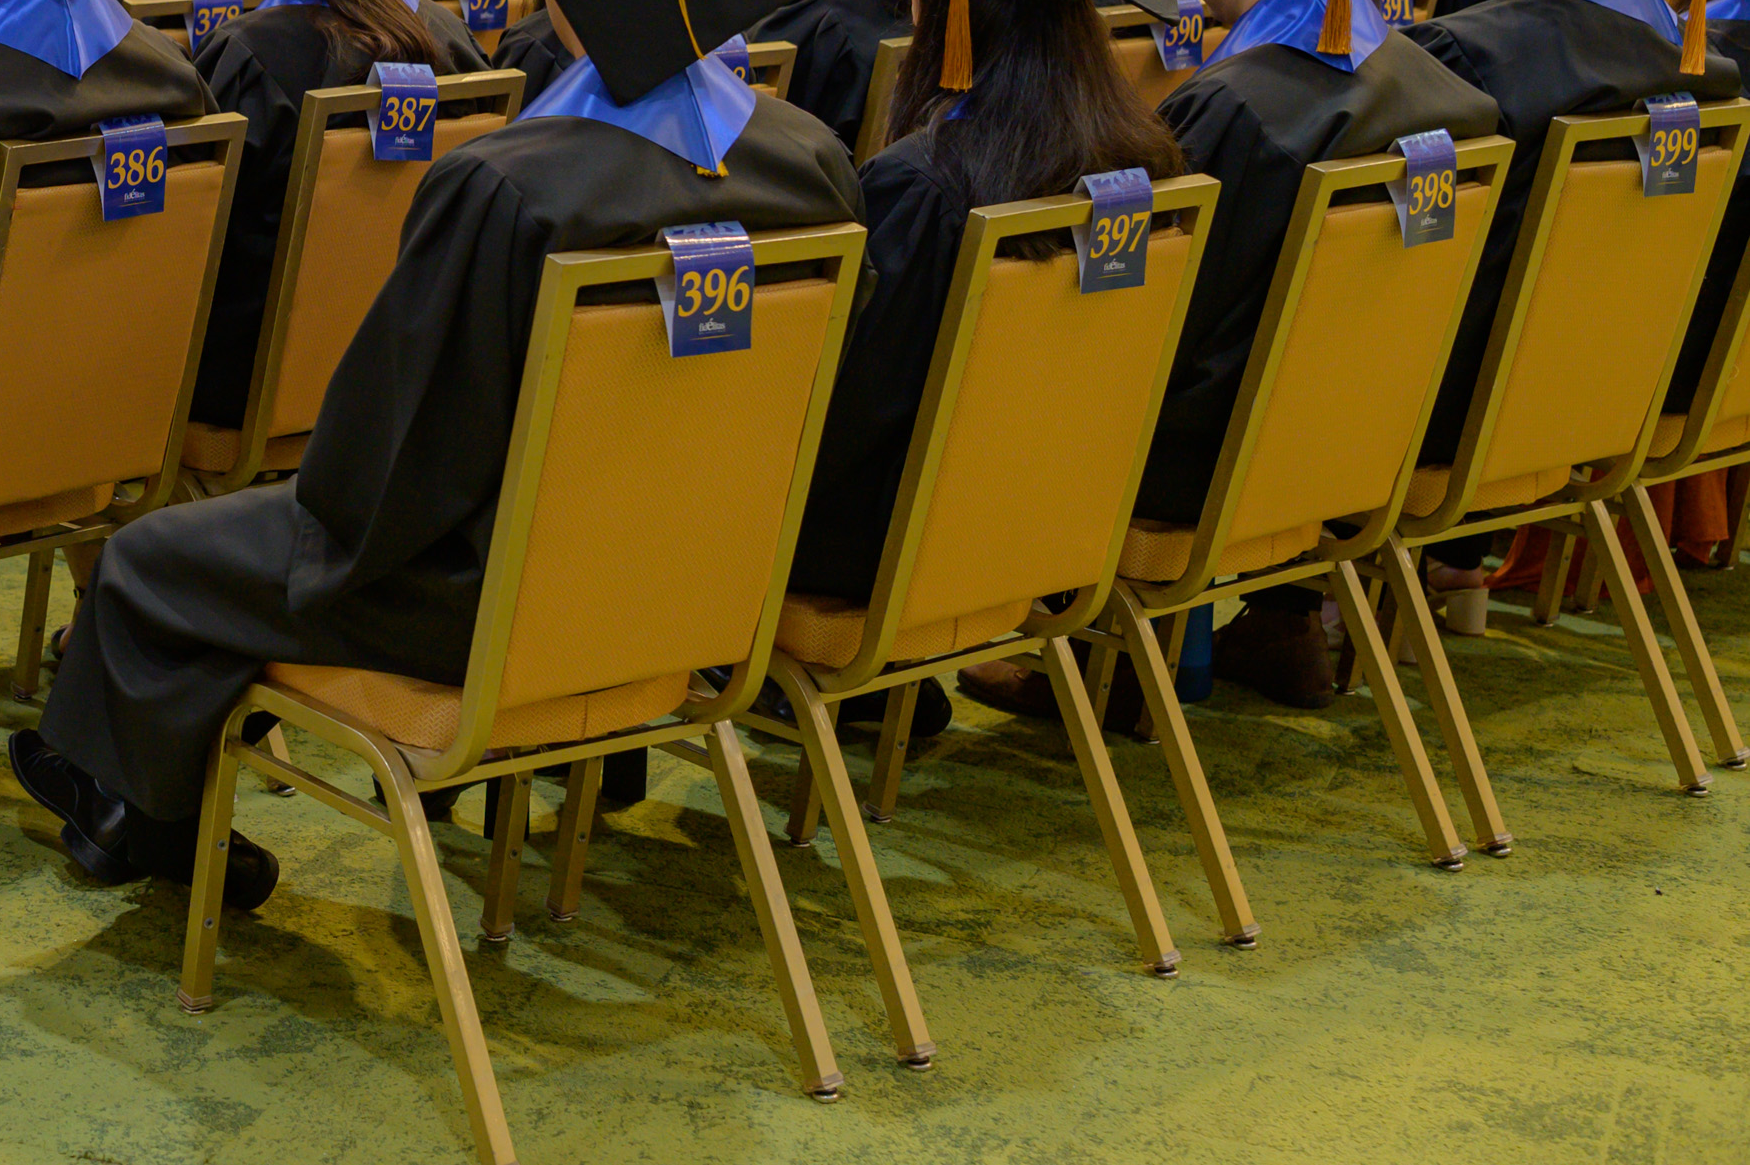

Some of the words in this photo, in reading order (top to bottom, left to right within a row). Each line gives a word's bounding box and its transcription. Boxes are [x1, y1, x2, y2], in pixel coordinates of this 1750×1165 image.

[1165, 14, 1203, 47] 390
[381, 96, 437, 132] 387
[107, 145, 164, 189] 386
[1651, 127, 1697, 167] 399
[1409, 169, 1454, 215] 398
[1090, 211, 1151, 259] 397
[678, 265, 750, 317] 396
